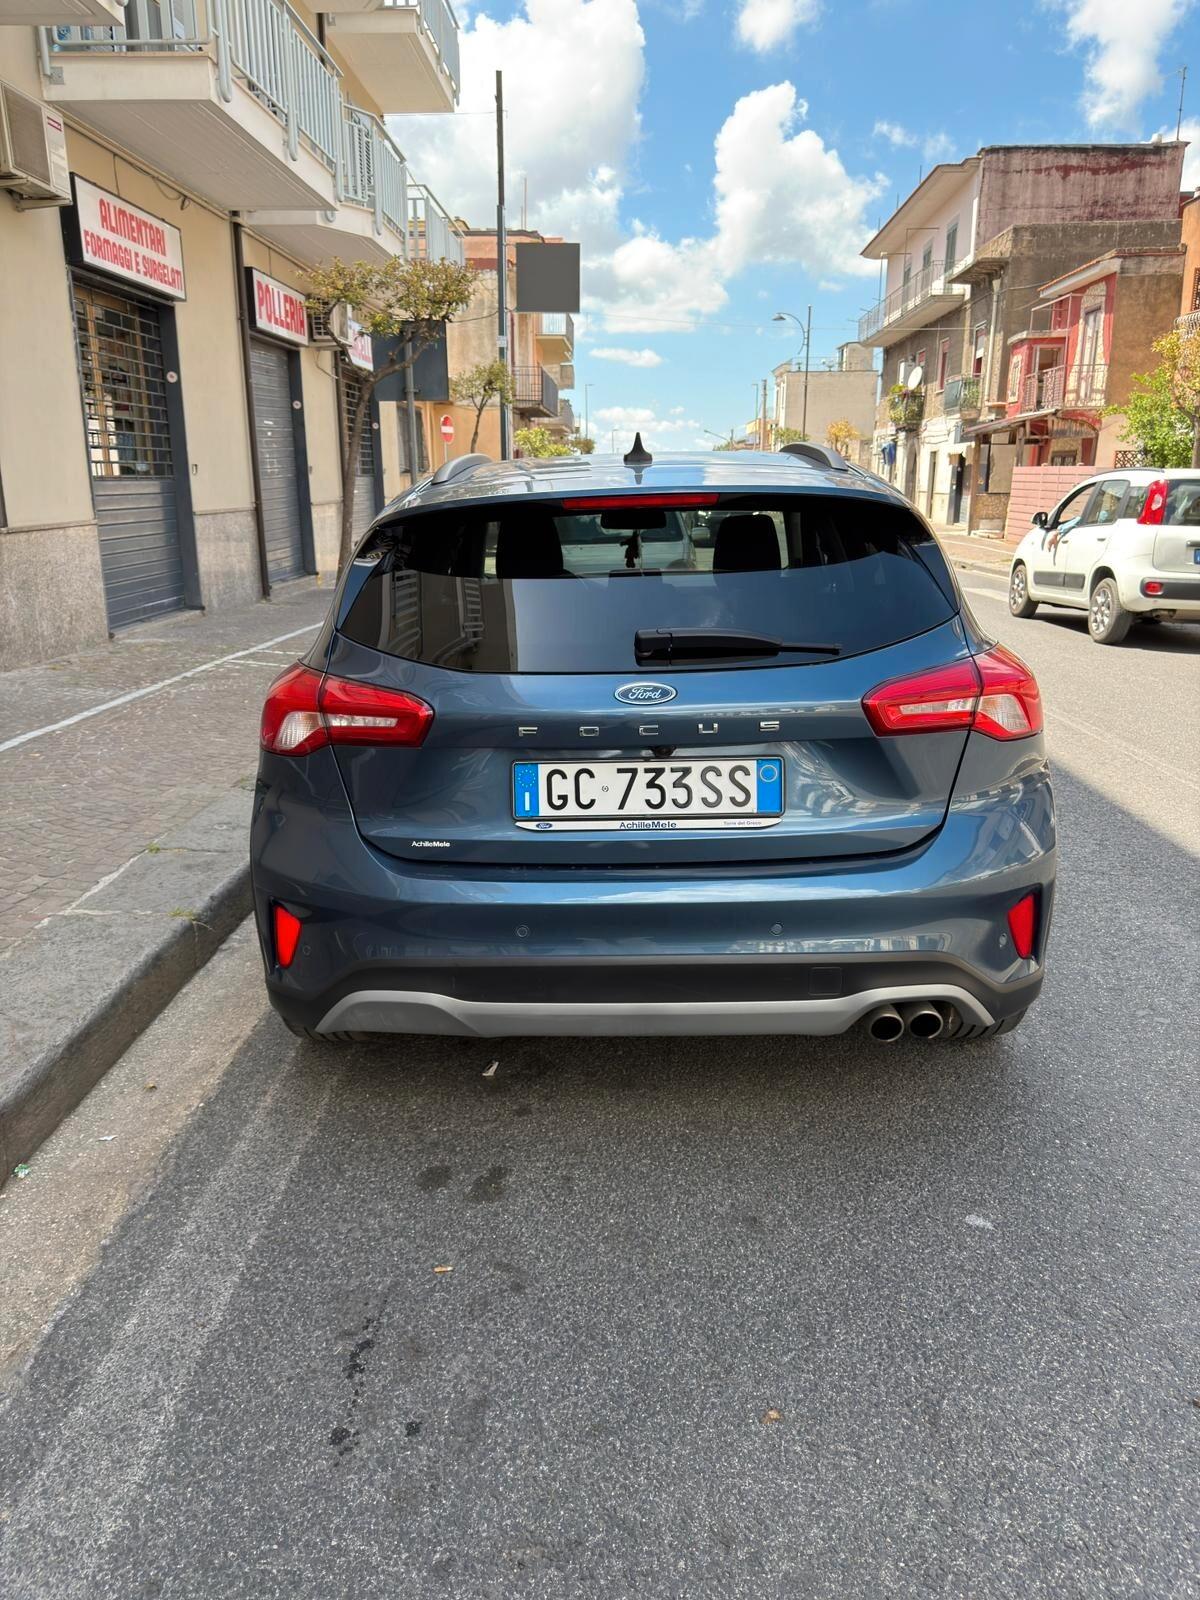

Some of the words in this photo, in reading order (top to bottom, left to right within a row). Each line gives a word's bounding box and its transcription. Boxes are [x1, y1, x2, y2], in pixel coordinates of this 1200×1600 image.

[99, 198, 167, 257] ALIMENTARI
[83, 229, 134, 272] FORMAGGI
[134, 251, 141, 275] E
[142, 254, 183, 291] SURGELATI
[256, 279, 306, 337] POLLERIA
[628, 687, 663, 700] Ford
[518, 721, 780, 737] FOCUS
[546, 768, 596, 810] GC
[616, 765, 751, 810] 733SS
[619, 820, 677, 829] AchilleMele
